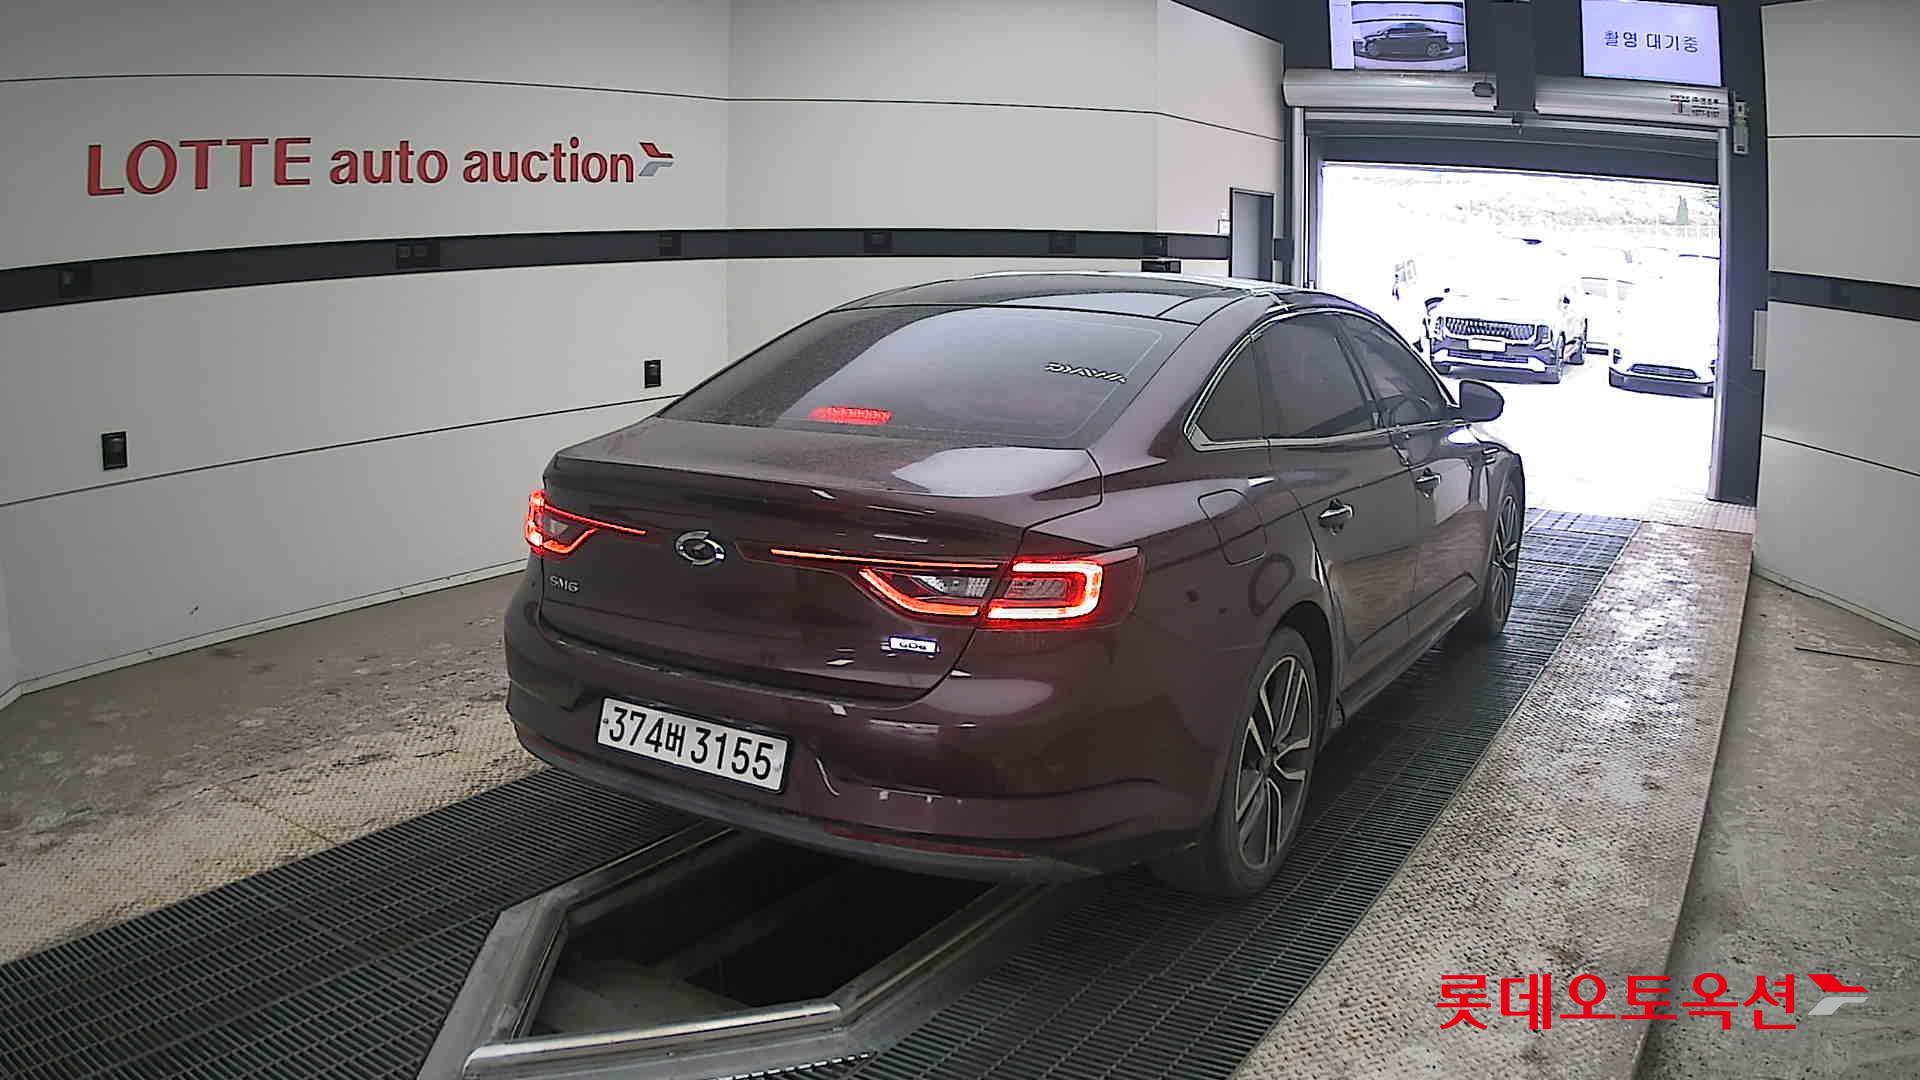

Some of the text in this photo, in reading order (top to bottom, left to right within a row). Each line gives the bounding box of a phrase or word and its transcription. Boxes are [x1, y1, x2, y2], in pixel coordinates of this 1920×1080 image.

[1604, 31, 1698, 53] 촬영 대기중
[87, 136, 635, 196] LOTTE auto auction
[550, 575, 579, 592] SM6
